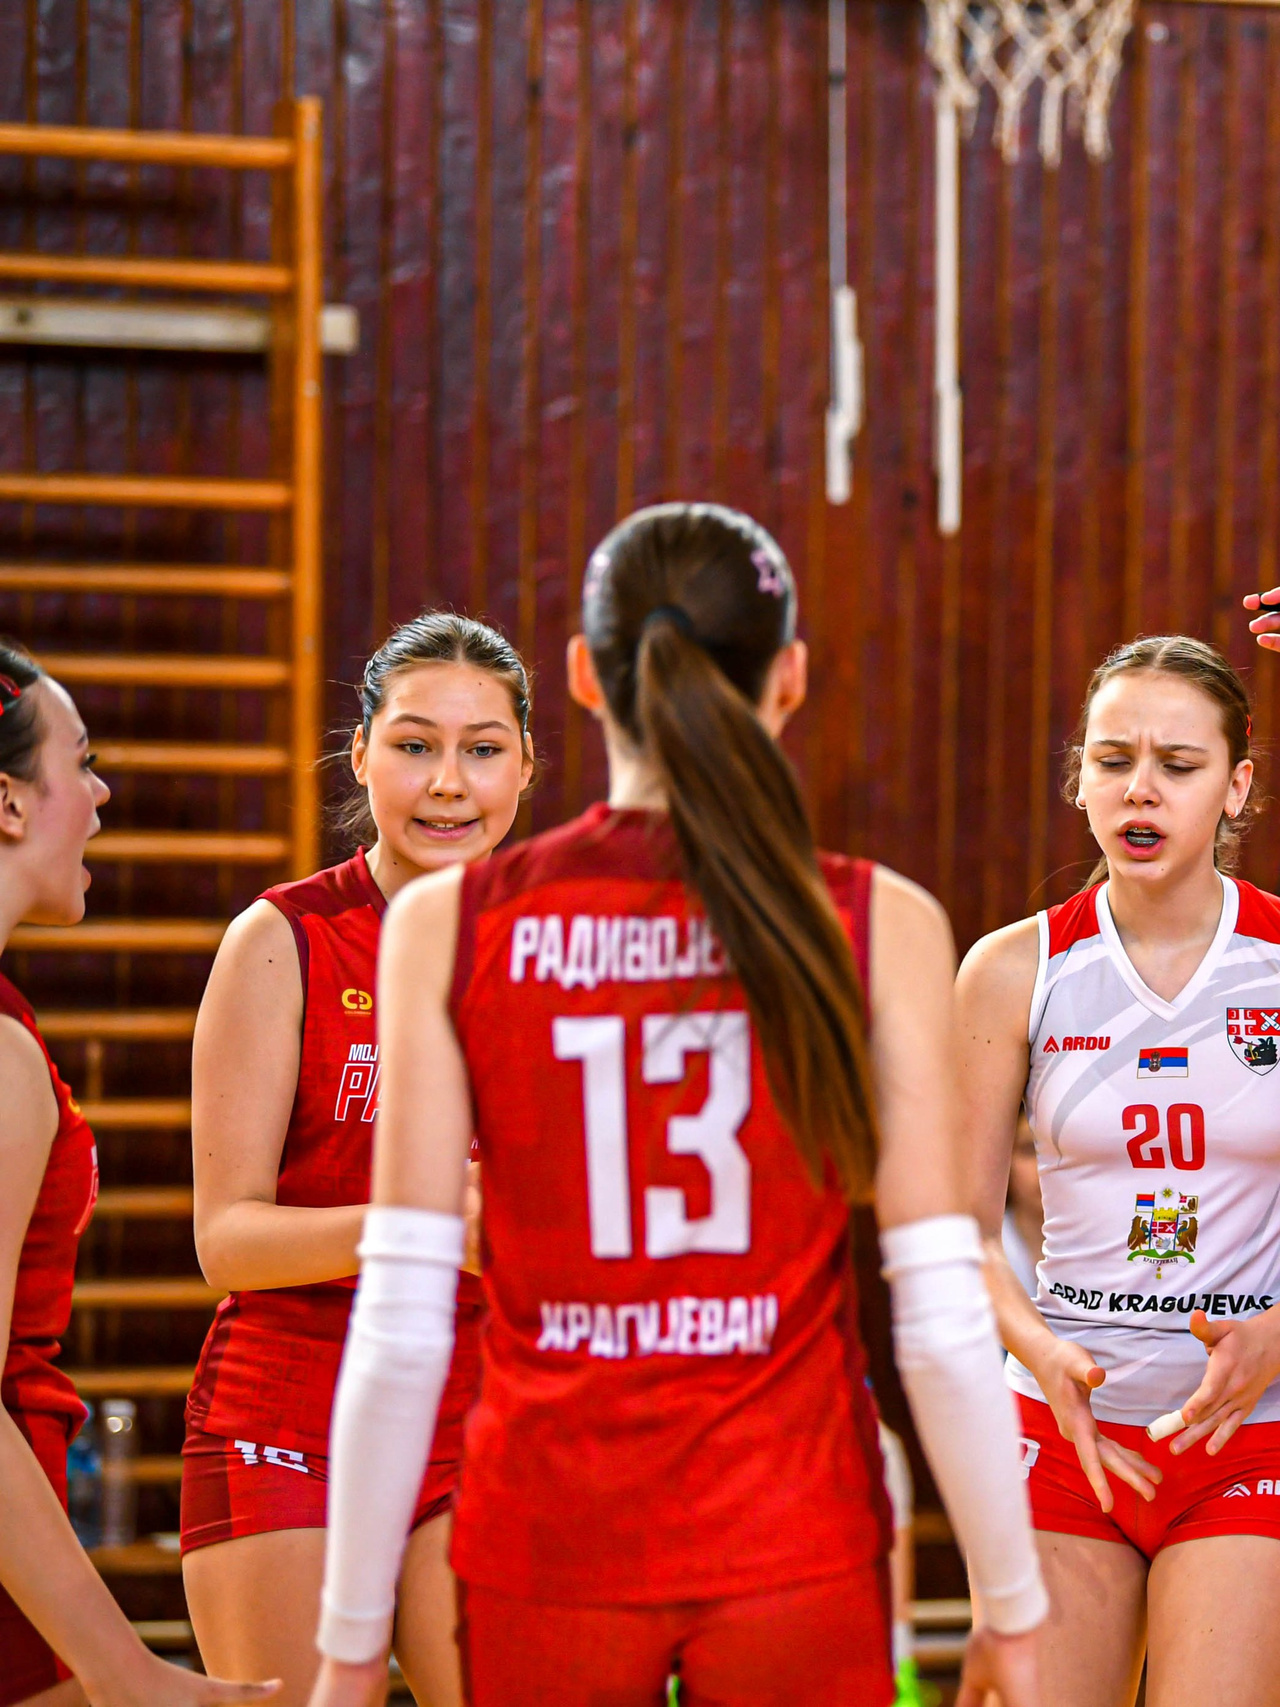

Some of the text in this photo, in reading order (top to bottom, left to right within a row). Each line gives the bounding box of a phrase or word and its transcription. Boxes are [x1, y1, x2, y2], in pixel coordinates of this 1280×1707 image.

[1062, 1036, 1111, 1051] ARDU
[552, 1011, 752, 1259] 13
[1122, 1103, 1206, 1170] 20
